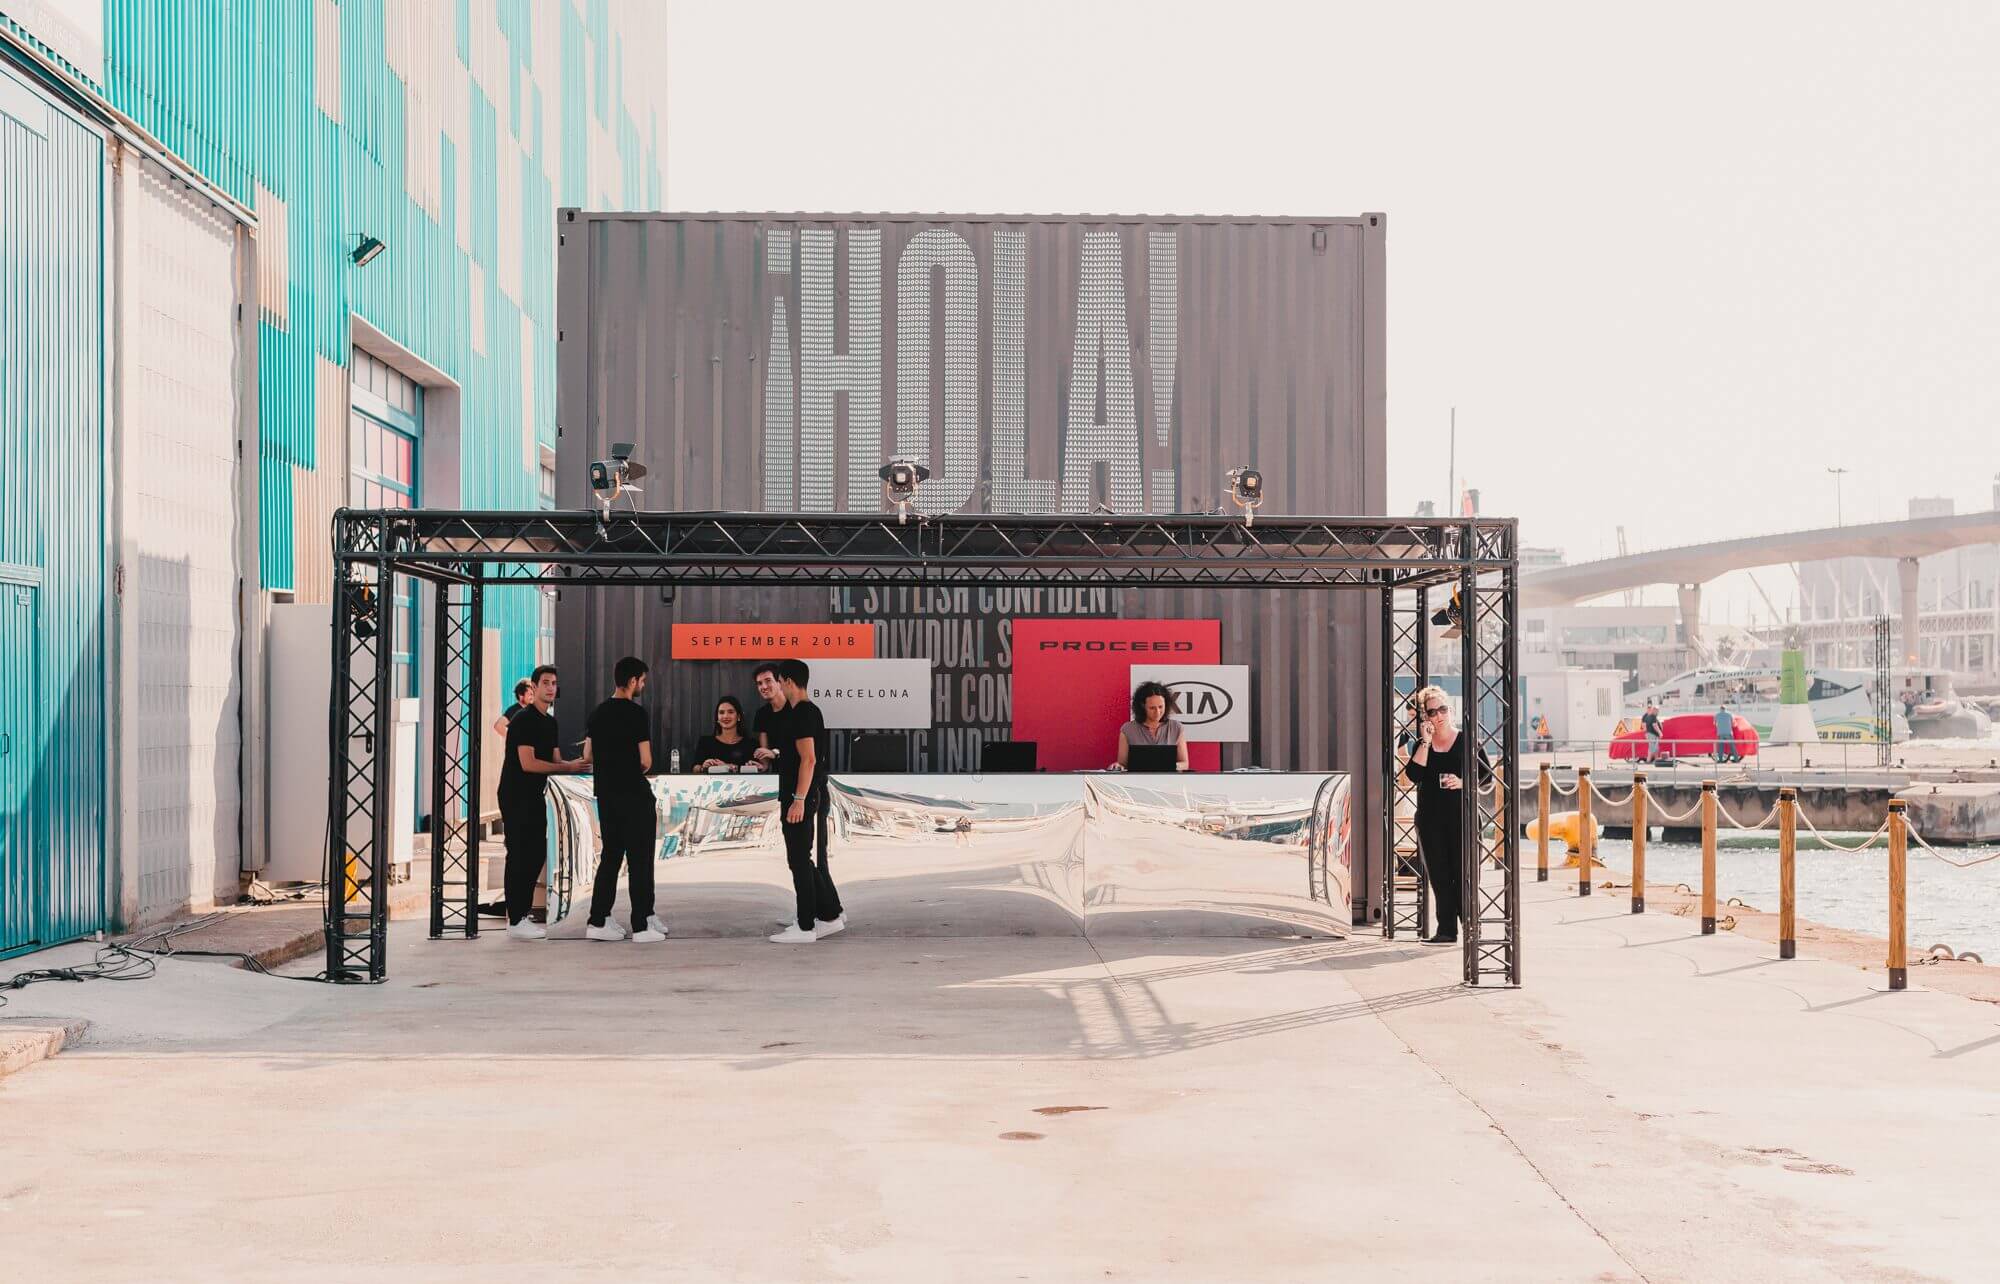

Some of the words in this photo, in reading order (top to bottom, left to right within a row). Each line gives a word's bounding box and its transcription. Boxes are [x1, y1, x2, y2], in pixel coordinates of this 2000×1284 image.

[864, 576, 969, 613] STYLISH
[691, 636, 800, 646] SEPTEMBER
[812, 636, 856, 646] 2018
[1040, 641, 1193, 651] PROCEED
[813, 688, 910, 698] BARCELONA
